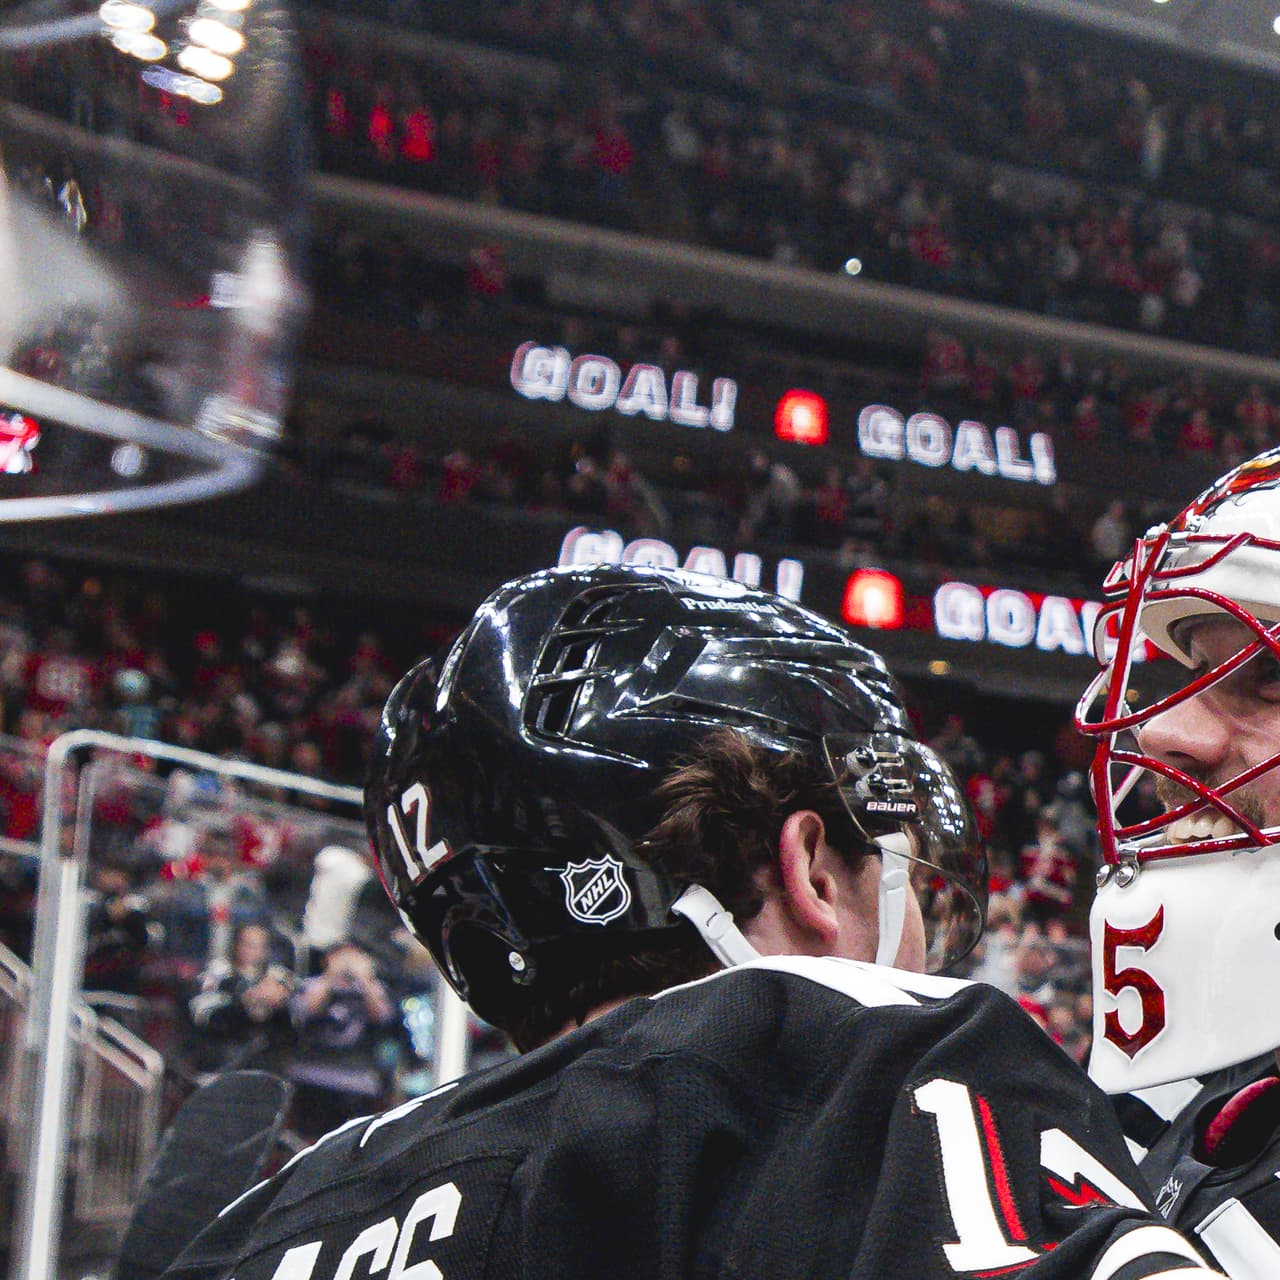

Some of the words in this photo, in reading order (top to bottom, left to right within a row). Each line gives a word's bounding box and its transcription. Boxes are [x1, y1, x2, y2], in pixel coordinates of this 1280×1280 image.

[680, 597, 780, 616] Prudential
[387, 782, 454, 885] 12
[579, 870, 616, 913] NHL
[1102, 903, 1167, 1061] 5
